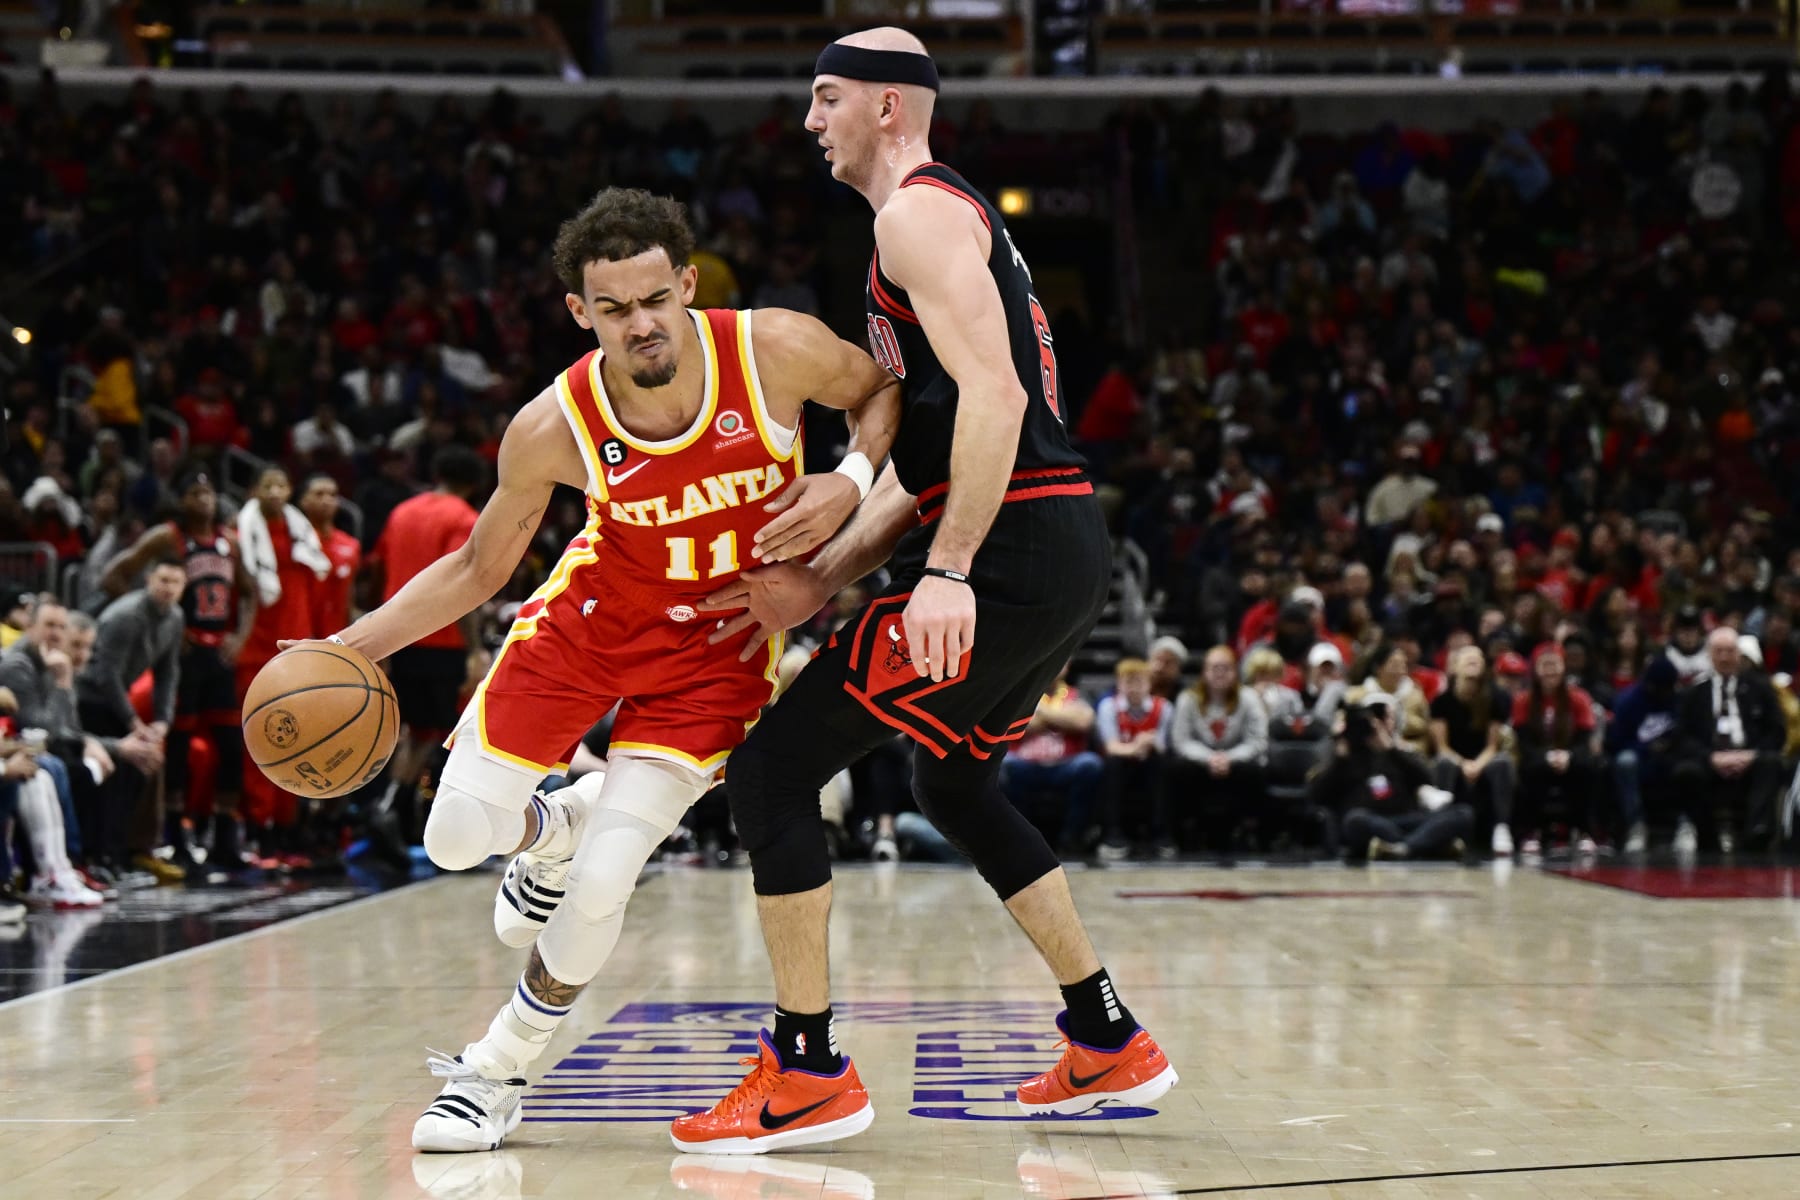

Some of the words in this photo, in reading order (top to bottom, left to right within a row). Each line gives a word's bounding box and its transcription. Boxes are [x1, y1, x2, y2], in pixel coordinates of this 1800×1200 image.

[604, 441, 623, 464] 6
[715, 433, 755, 450] sharecare
[610, 462, 785, 527] ATLANTA
[665, 529, 740, 581] 11
[665, 606, 698, 619] HAWKS
[520, 1030, 760, 1122] UNITED
